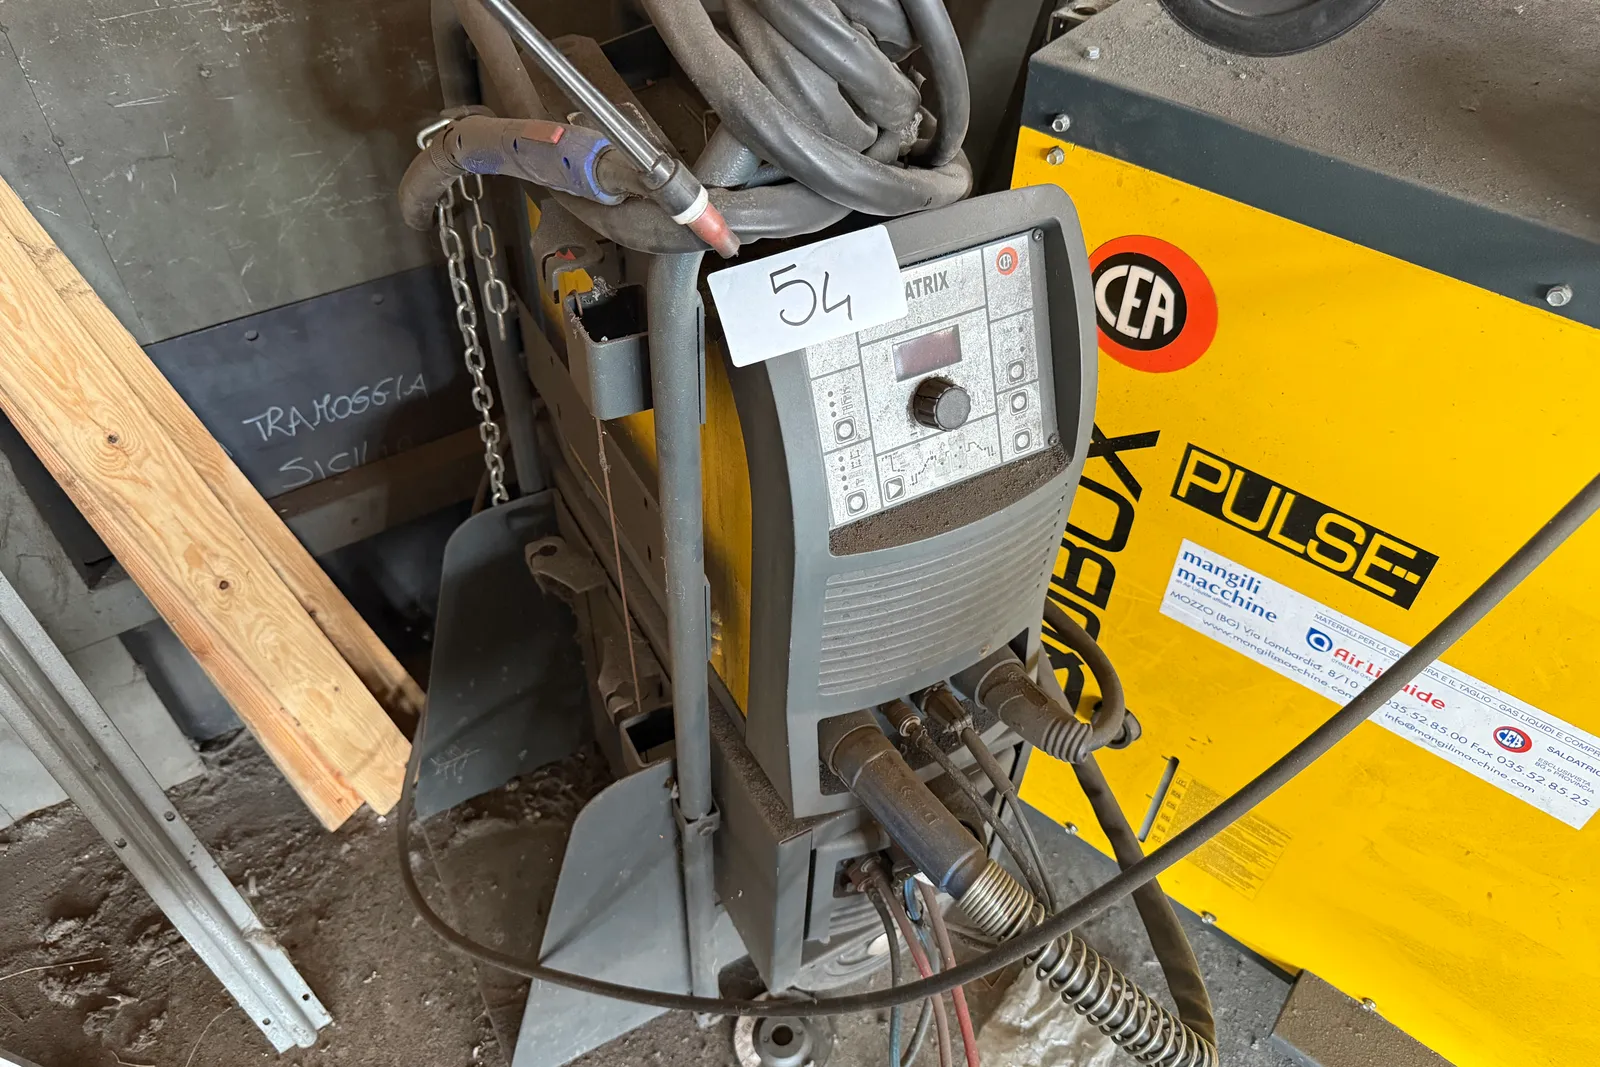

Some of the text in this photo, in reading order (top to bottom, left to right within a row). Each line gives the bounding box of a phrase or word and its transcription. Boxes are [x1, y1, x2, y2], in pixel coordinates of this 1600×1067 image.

[768, 264, 853, 326] 54
[904, 270, 949, 302] ATRIX
[1095, 264, 1175, 339] CEA
[242, 373, 428, 441] TRAMOGGIA
[1176, 447, 1421, 597] PULSE
[1177, 567, 1278, 623] macchine
[1182, 550, 1262, 595] mangili
[1170, 591, 1214, 616] MOZZO
[1216, 612, 1240, 630] (BG)
[1243, 625, 1261, 640] Via
[1328, 669, 1359, 689] 8/10
[1334, 648, 1364, 669] Air
[1314, 613, 1356, 638] MATERIALI
[1357, 634, 1375, 647] PER
[1376, 643, 1388, 653] LA
[1448, 679, 1456, 687] IL
[1459, 684, 1492, 703] TAGLIO
[1499, 704, 1519, 717] GAS
[1519, 714, 1556, 735] LIQUIDI
[1556, 731, 1564, 739] E
[1384, 712, 1536, 793] info@mangilimacchine.com
[1470, 742, 1494, 758] Fax
[1496, 755, 1591, 807] 035.52.85.25
[1534, 761, 1547, 771] BG
[1553, 770, 1595, 795] PROVINCIA
[1537, 757, 1592, 787] ESCLUSIVISTA
